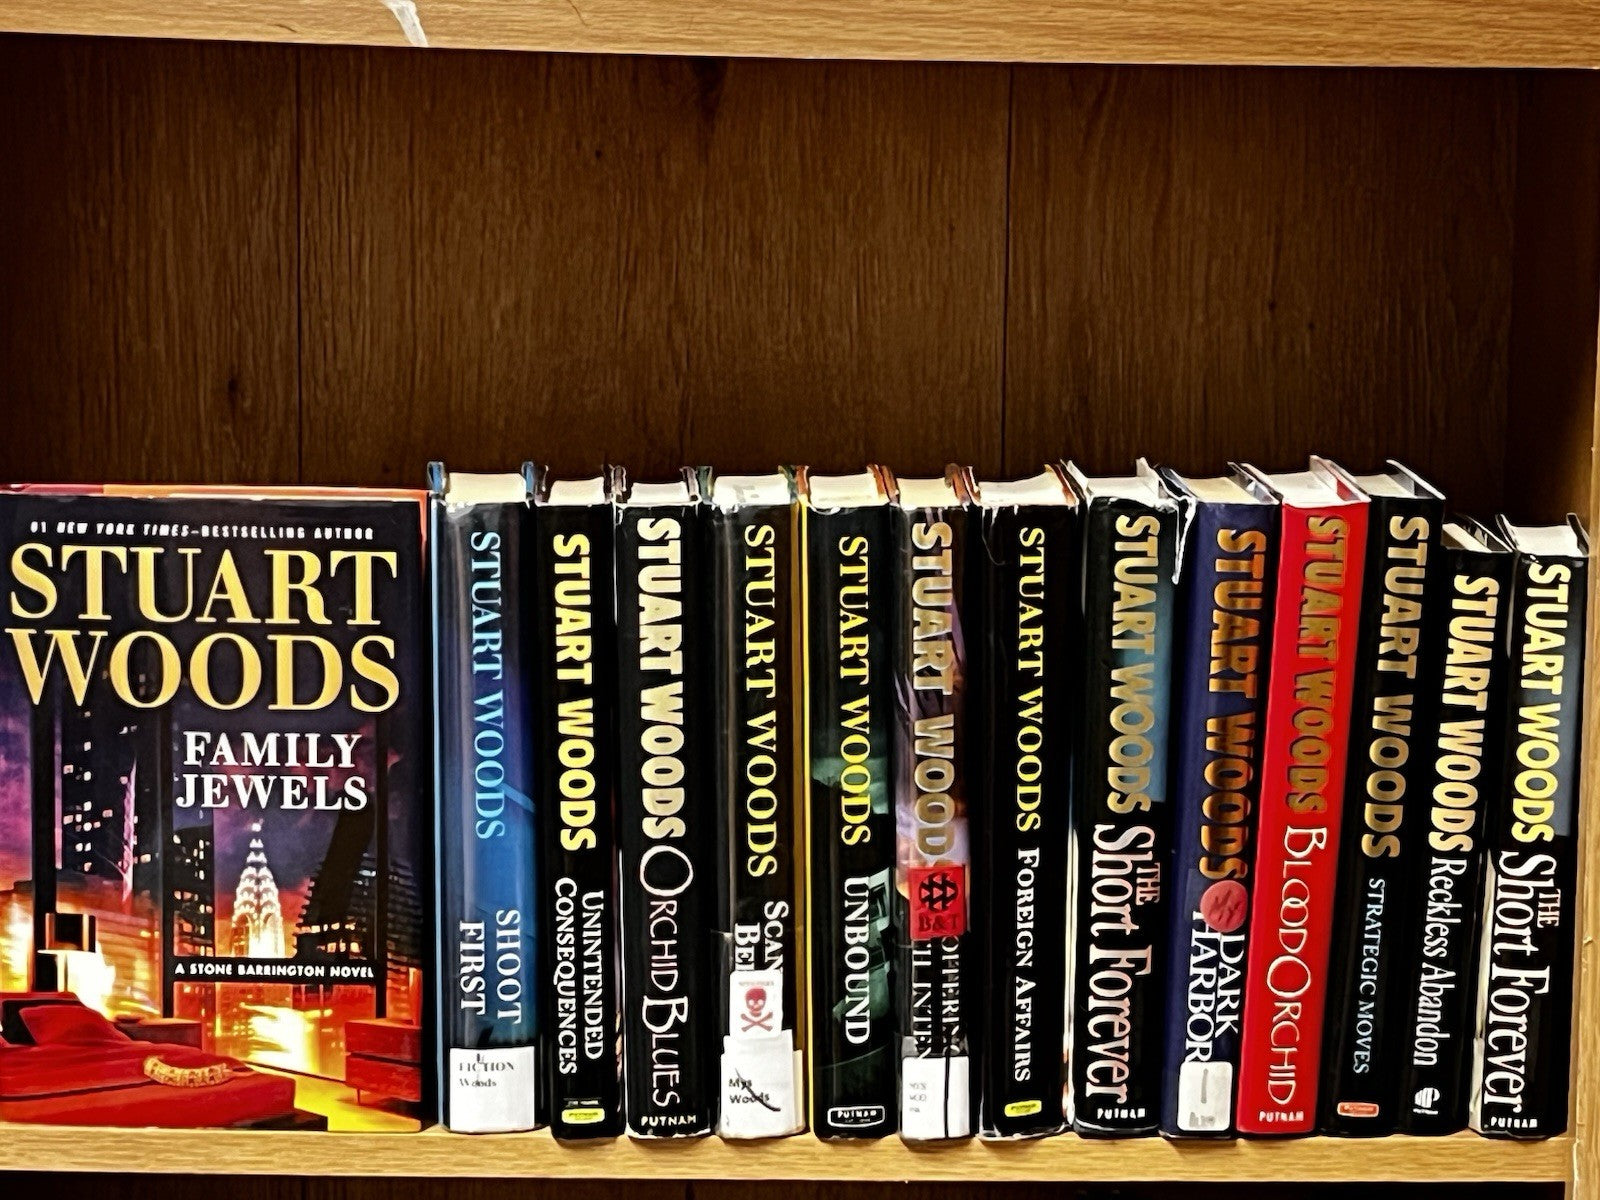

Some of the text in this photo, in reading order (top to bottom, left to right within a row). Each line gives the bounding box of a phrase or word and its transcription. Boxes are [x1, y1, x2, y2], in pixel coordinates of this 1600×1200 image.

[10, 542, 398, 626] STUART
[56, 522, 88, 535] NEW
[96, 522, 135, 536] YORK
[314, 527, 374, 541] AUTHOR
[4, 627, 400, 713] WOODS
[471, 531, 506, 840] STUART WOODS
[637, 517, 687, 840] STUART WOODS
[744, 524, 777, 699] STUART
[838, 535, 872, 846] STUART WOODS
[911, 521, 956, 861] STUART WOOD
[1016, 526, 1045, 832] STUART WOODS
[1106, 514, 1161, 815] STUART WOODS
[1285, 515, 1349, 815] STUART WOODS
[1360, 515, 1430, 859] STUART WOODS
[183, 730, 362, 768] FAMILY
[553, 533, 597, 851] STUART WOODS
[1199, 528, 1267, 880] STUART WOODS
[1427, 575, 1501, 853] STUART WOODS
[1511, 563, 1572, 843] STUART WOODS
[175, 773, 368, 811] JEWELS
[746, 709, 778, 878] WOODS
[844, 876, 870, 1044] UNBOUND
[918, 912, 959, 932] B&T
[1015, 847, 1041, 970] FOREIGN
[1136, 862, 1161, 906] THE
[1359, 878, 1386, 993] STRATEGIC
[1413, 857, 1468, 1066] Reckless Abandon
[1537, 887, 1562, 929] THE
[174, 963, 374, 978] A STONE BARRINGTON NOVEL
[459, 920, 486, 1017] FIRST
[496, 909, 522, 1025] SHOOT
[552, 877, 578, 1076] CONSEQUENCES
[581, 890, 604, 1060] UNINTENDED
[639, 844, 694, 1108] ORCHID BLUES
[1014, 975, 1037, 1082] AFFAIRS
[1086, 824, 1156, 1104] Short Forever
[1185, 911, 1222, 1062] HARBOR
[1214, 933, 1246, 1038] DARK
[1266, 825, 1328, 1106] BLOOD ORCHID
[1352, 1001, 1376, 1075] MOVES
[1483, 850, 1557, 1114] Short Forever
[459, 1061, 515, 1072] FICTION
[641, 1114, 697, 1127] PUTNAM
[1097, 1108, 1145, 1120] PUTNAM
[1258, 1110, 1304, 1123] PUTNAM
[1490, 1116, 1538, 1128] PUTNAM
